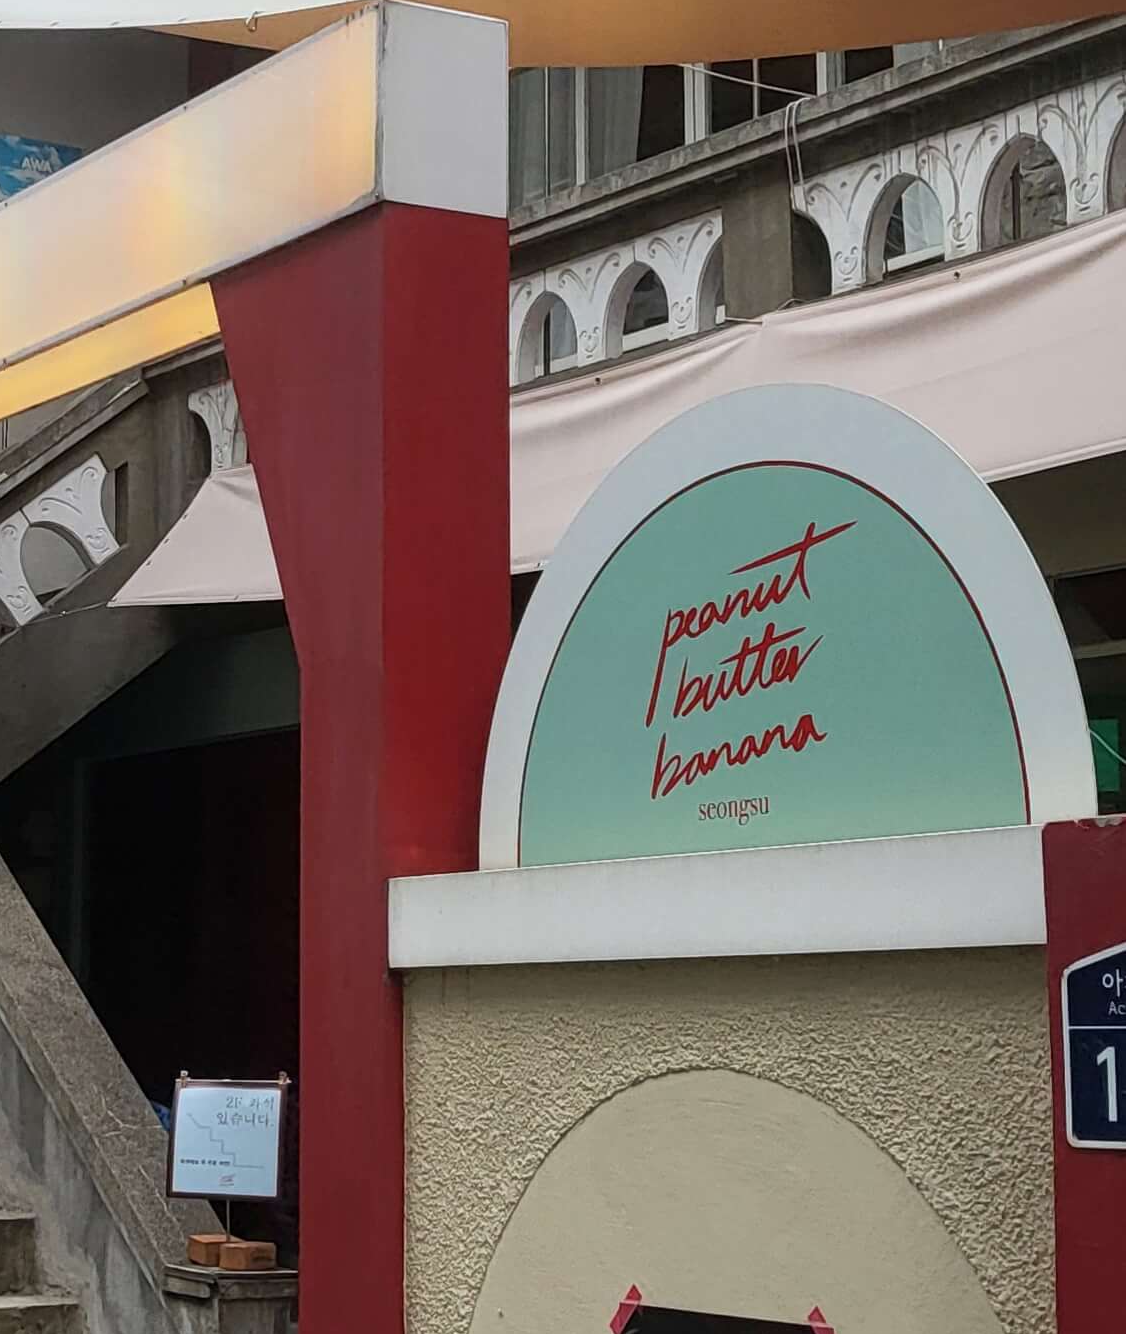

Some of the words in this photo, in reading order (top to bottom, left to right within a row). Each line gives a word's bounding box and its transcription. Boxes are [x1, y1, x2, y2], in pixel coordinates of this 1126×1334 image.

[645, 520, 858, 727] peanut
[673, 622, 824, 719] butter
[650, 713, 828, 800] banana
[697, 793, 770, 826] seongsu
[1102, 968, 1126, 998] 아
